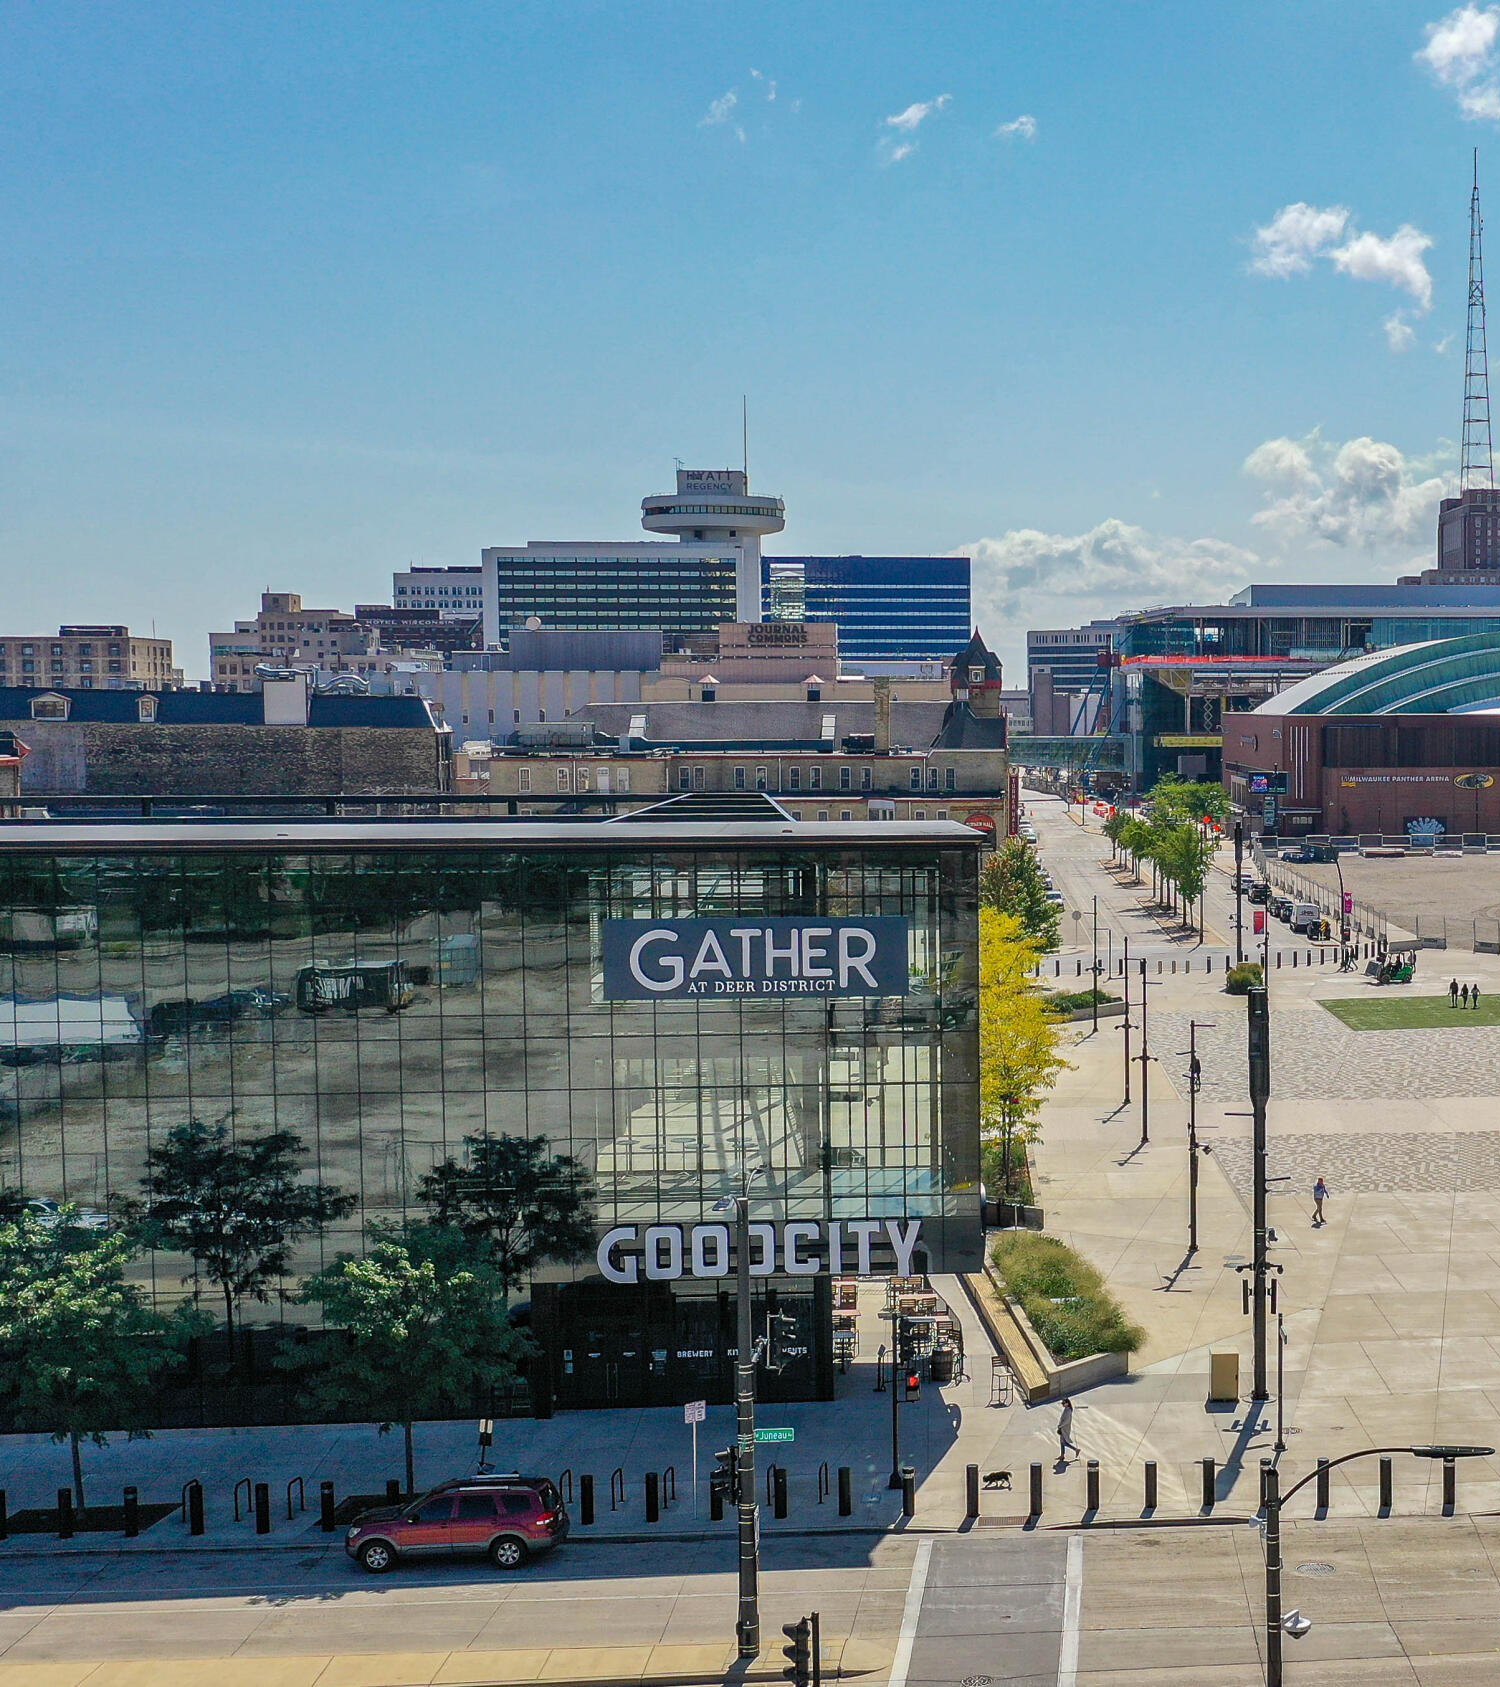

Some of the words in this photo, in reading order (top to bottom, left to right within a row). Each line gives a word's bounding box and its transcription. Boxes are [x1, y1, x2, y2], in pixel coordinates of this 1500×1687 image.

[686, 471, 731, 481] HYATT
[686, 482, 733, 490] REGENCY
[748, 624, 808, 634] JOURNAL
[748, 634, 808, 643] COMMONS
[629, 927, 879, 992] GATHER
[687, 981, 709, 993] AT
[714, 980, 756, 993] DEER
[762, 979, 836, 992] DISTRICT
[677, 1350, 714, 1358] BREWERY
[779, 1346, 808, 1355] VENTS
[760, 1431, 787, 1440] Juneau
